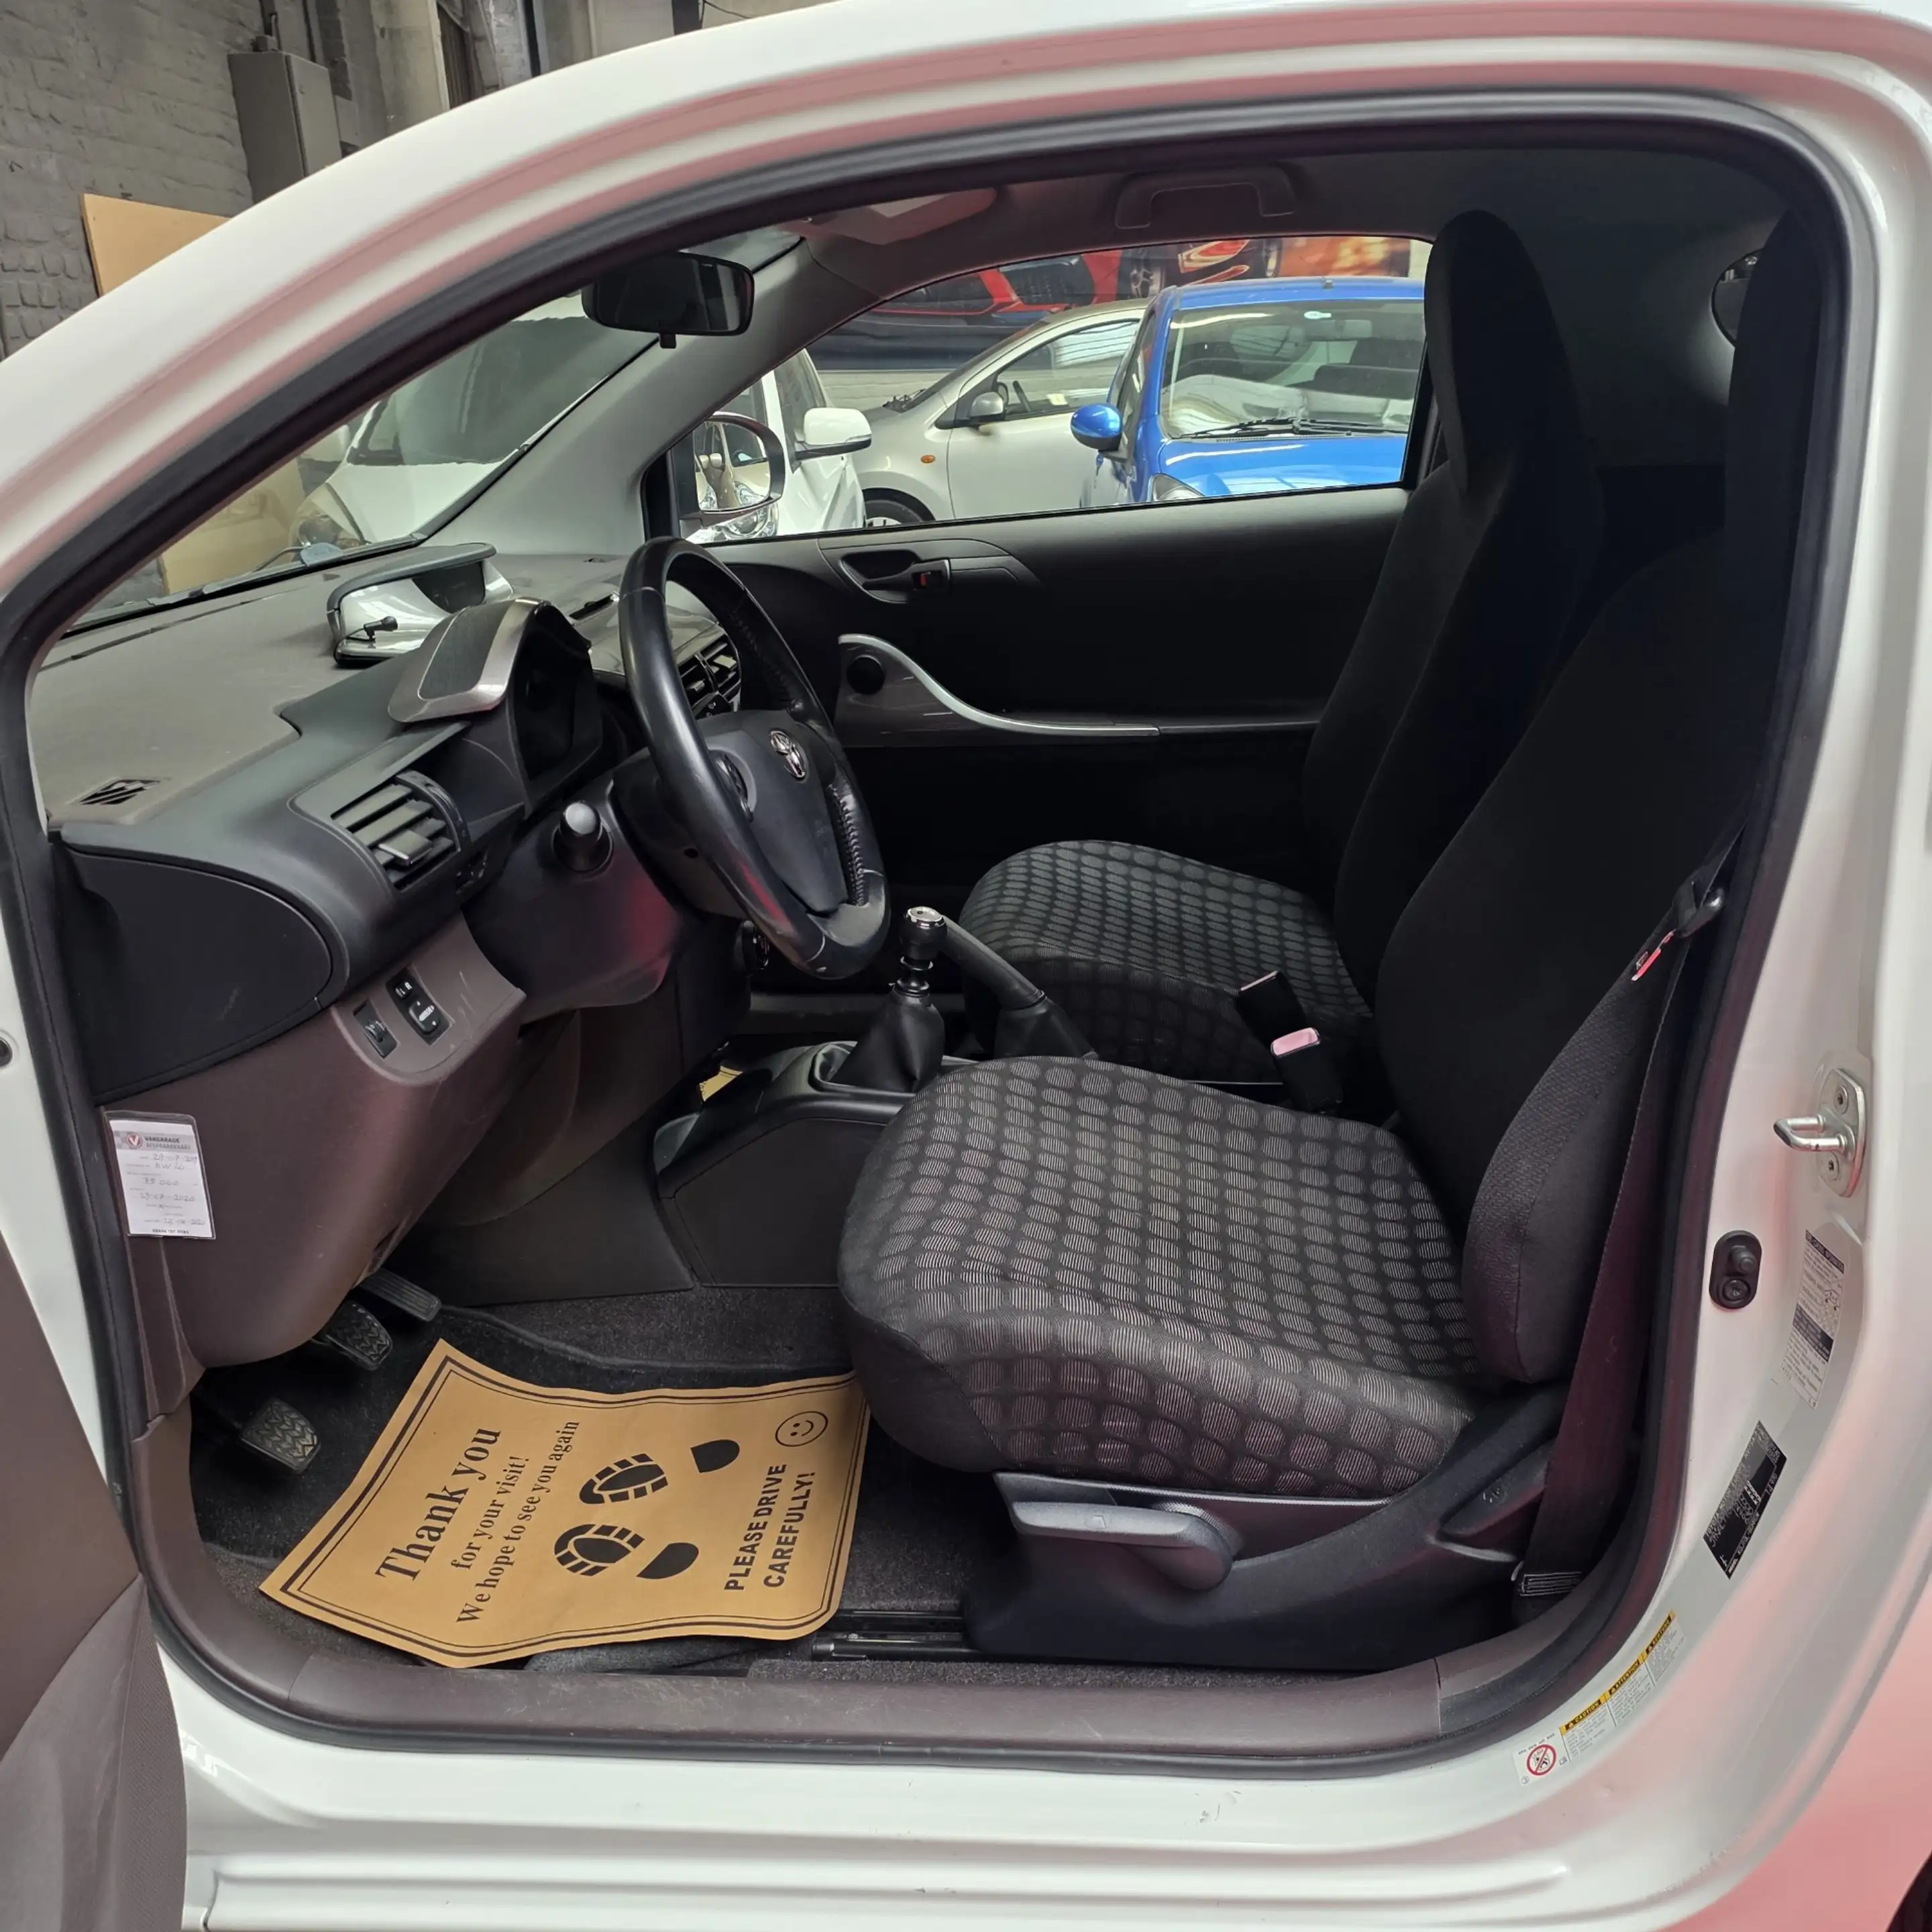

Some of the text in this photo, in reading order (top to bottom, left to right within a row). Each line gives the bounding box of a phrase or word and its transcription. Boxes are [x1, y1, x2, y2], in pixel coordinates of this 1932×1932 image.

[374, 1429, 501, 1581] Thank you
[451, 1456, 529, 1569] for your visit!
[456, 1421, 580, 1622] We hope to see you again
[724, 1464, 787, 1591] PLEASE DRIVE
[763, 1472, 815, 1588] CAREFULLY!
[1574, 1702, 1599, 1722] CAUTION
